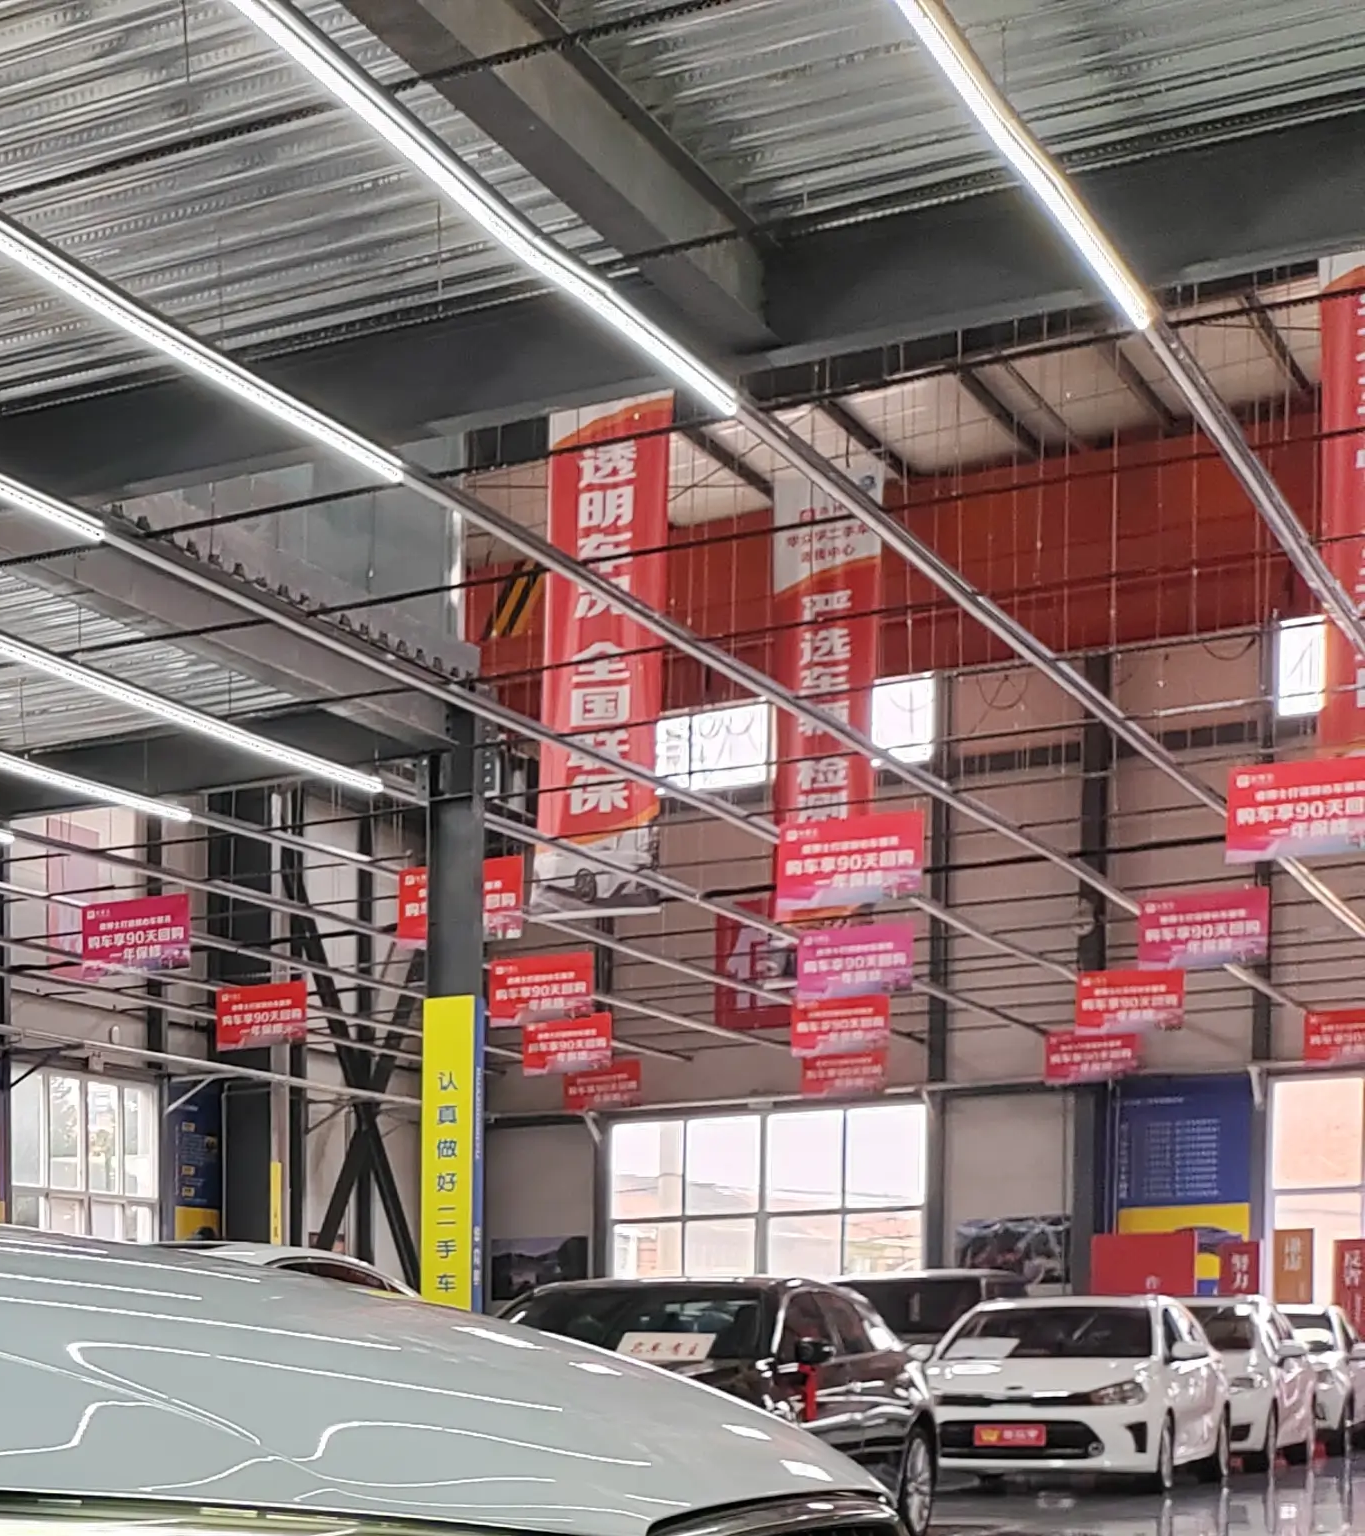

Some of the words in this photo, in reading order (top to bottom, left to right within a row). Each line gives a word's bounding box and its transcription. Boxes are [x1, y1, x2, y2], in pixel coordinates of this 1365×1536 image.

[436, 1071, 459, 1293] 认真做好二手车
